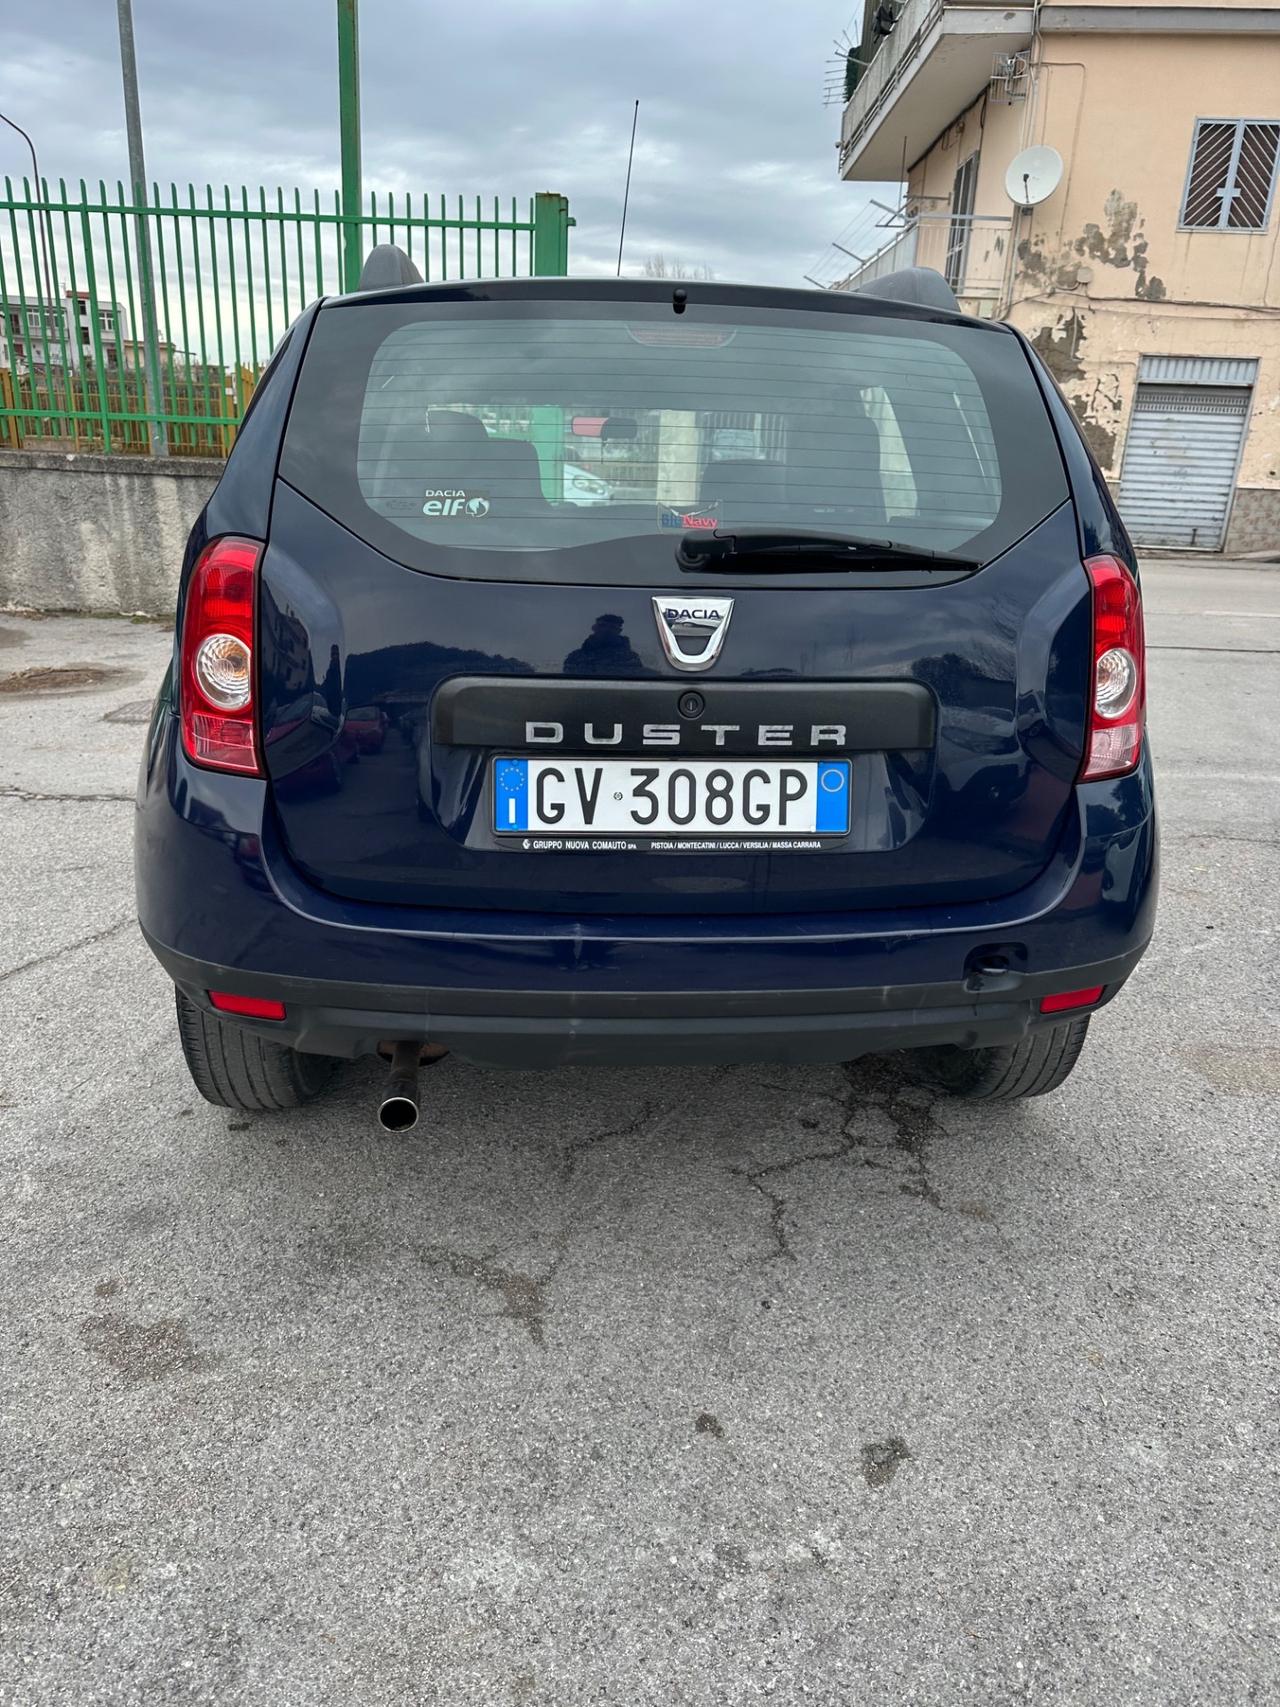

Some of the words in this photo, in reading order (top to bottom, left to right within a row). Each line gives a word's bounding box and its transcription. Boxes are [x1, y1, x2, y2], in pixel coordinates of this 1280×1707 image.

[425, 489, 466, 497] DACIA
[422, 499, 465, 516] elf
[667, 608, 720, 620] DACIA
[525, 721, 847, 746] DUSTER
[536, 767, 603, 825] GV
[630, 768, 808, 826] 308GP
[508, 798, 516, 823] I
[533, 840, 563, 849] GRUPPO
[565, 840, 590, 849] NUOVA
[592, 840, 627, 849] COMAUTO
[650, 841, 674, 849] PISTOIA
[677, 841, 716, 849] MONTECATINI
[719, 841, 739, 849] LUCCA
[742, 841, 769, 849] VERSILIA
[772, 841, 793, 849] MASSA
[792, 840, 821, 849] CARRARA
